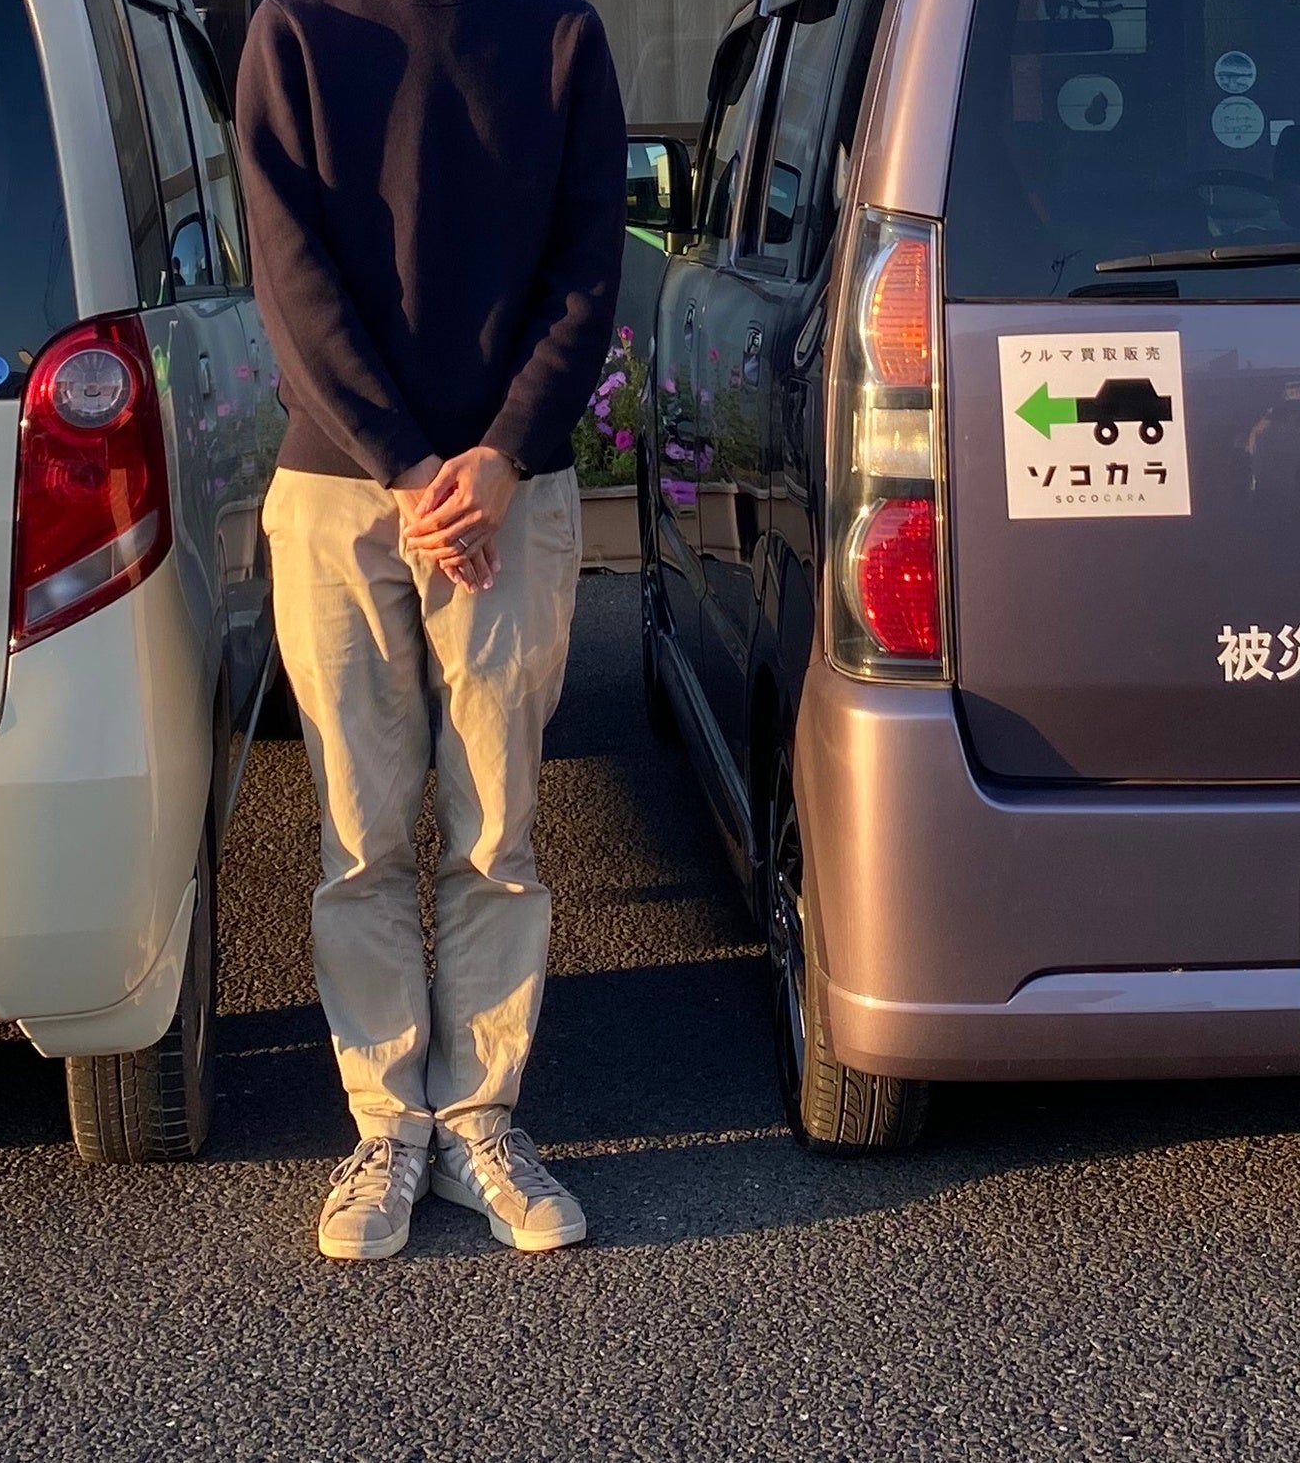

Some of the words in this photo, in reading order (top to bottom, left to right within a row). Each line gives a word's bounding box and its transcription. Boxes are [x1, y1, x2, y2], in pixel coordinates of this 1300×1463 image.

[1019, 346, 1161, 364] クルマ買取販売
[1026, 461, 1168, 488] ソコカラ
[1055, 493, 1146, 504] SOCOCARA
